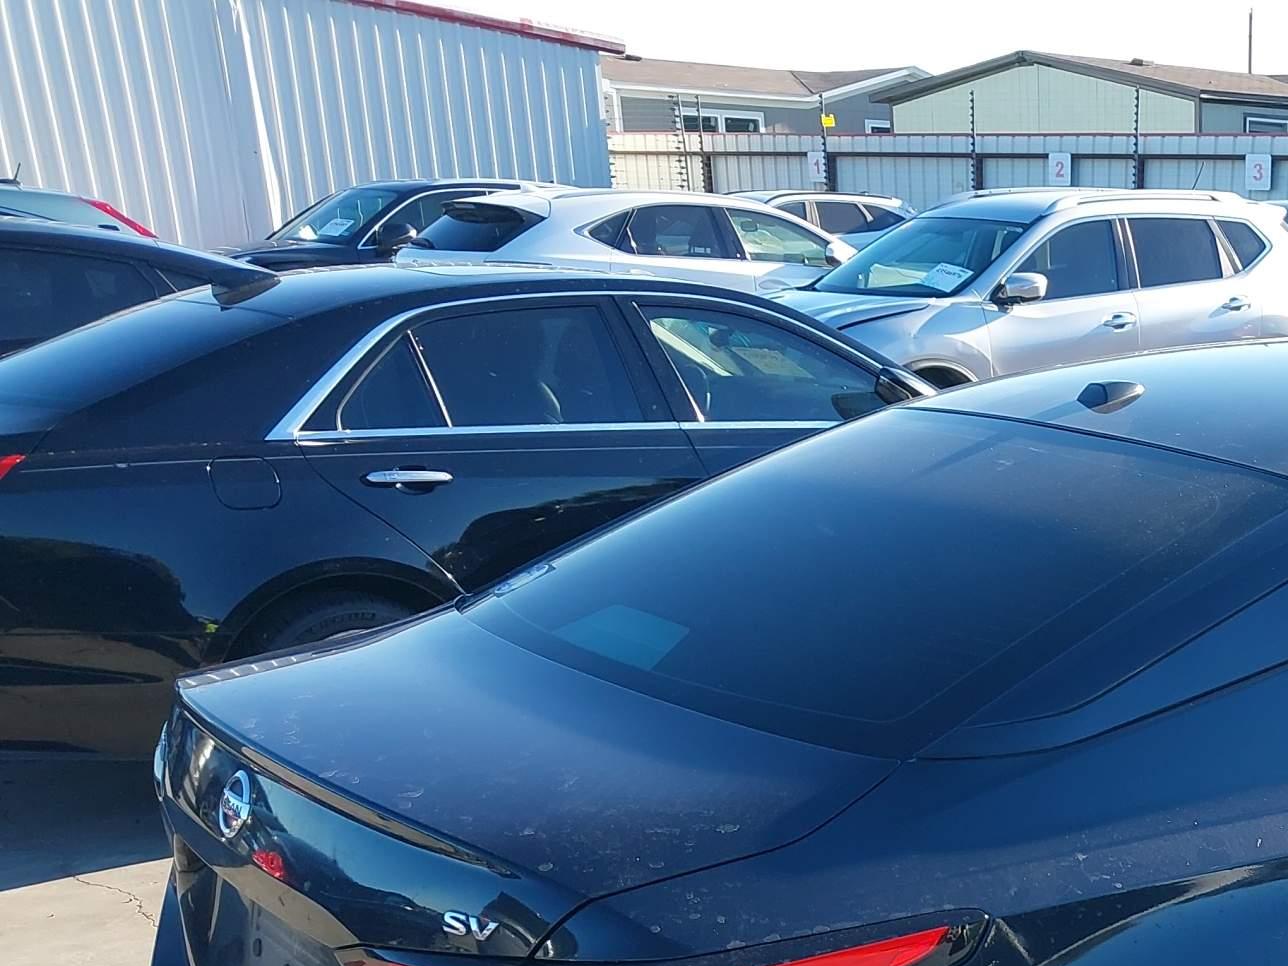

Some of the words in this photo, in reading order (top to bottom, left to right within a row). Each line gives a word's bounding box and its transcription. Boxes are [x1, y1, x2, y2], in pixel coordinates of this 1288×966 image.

[813, 159, 821, 175] 1
[1055, 160, 1065, 178] 2
[1253, 163, 1264, 182] 3
[441, 911, 500, 941] SV
